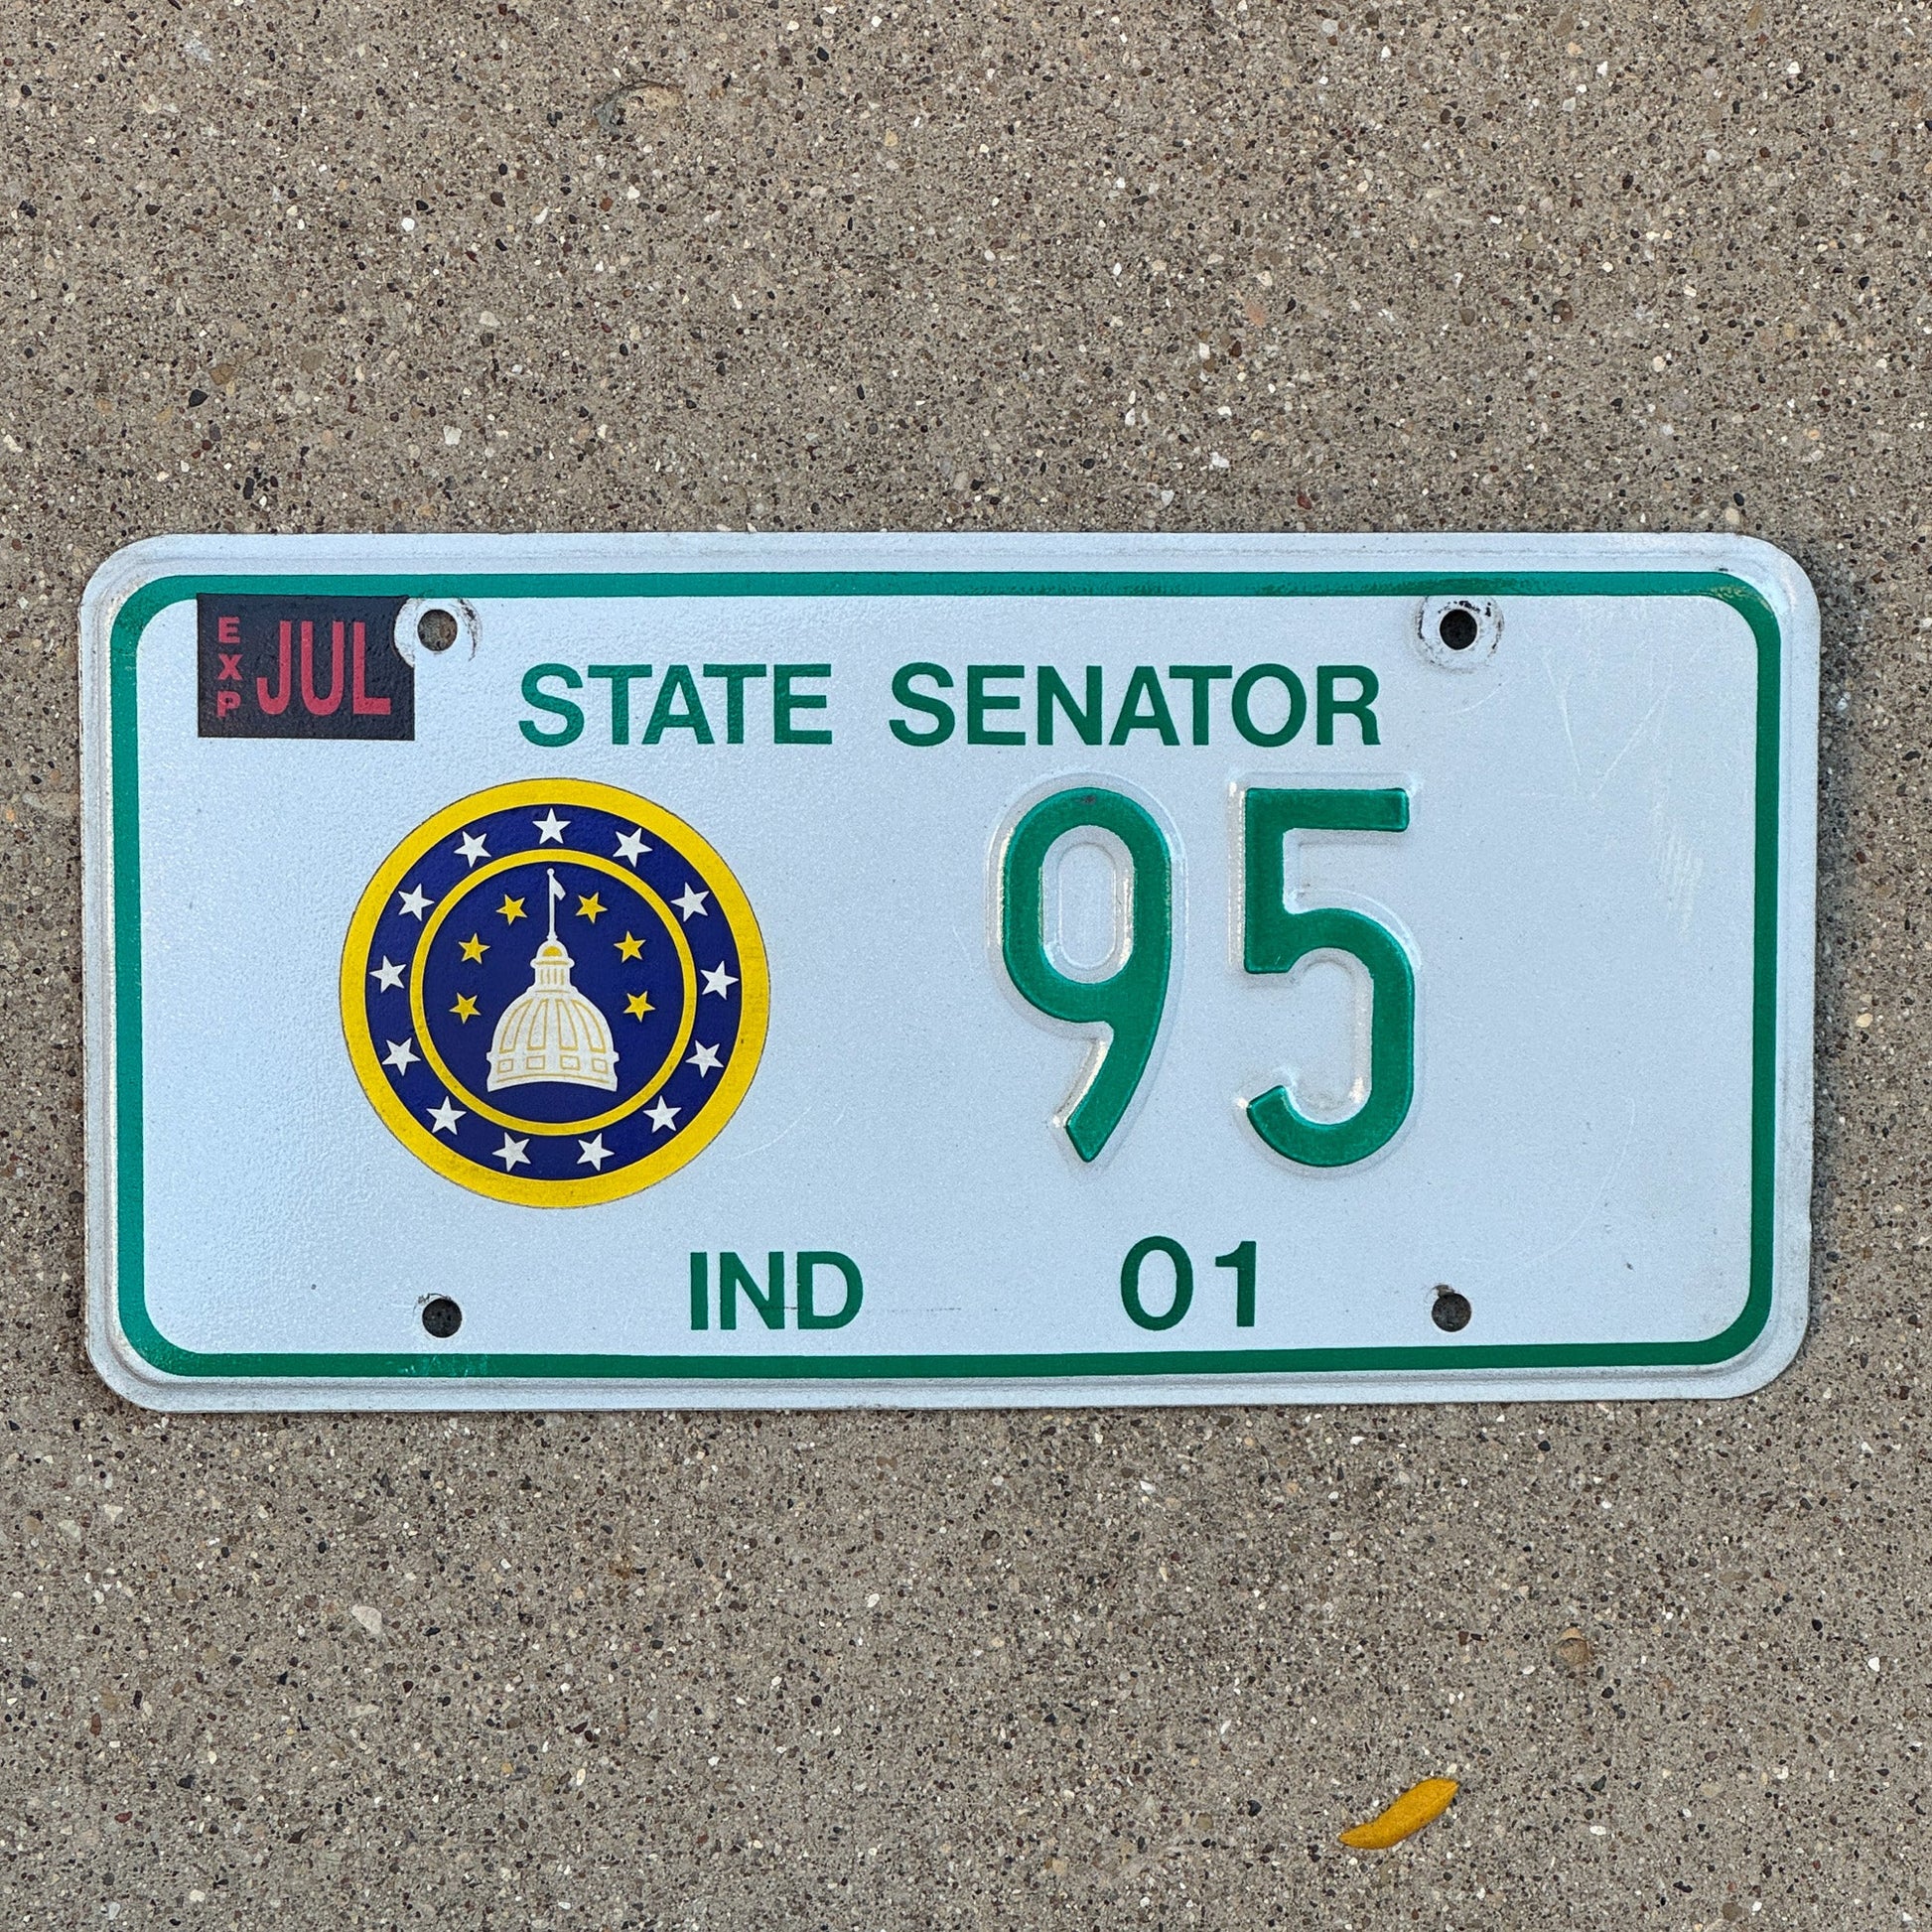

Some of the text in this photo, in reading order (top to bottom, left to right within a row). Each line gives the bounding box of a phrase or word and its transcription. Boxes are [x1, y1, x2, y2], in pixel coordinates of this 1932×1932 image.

[217, 617, 242, 718] EXP
[256, 620, 391, 716] JUL
[518, 662, 1380, 748] STATE SENATOR
[1000, 785, 1416, 1169] 95
[690, 1235, 1258, 1331] IND 01
